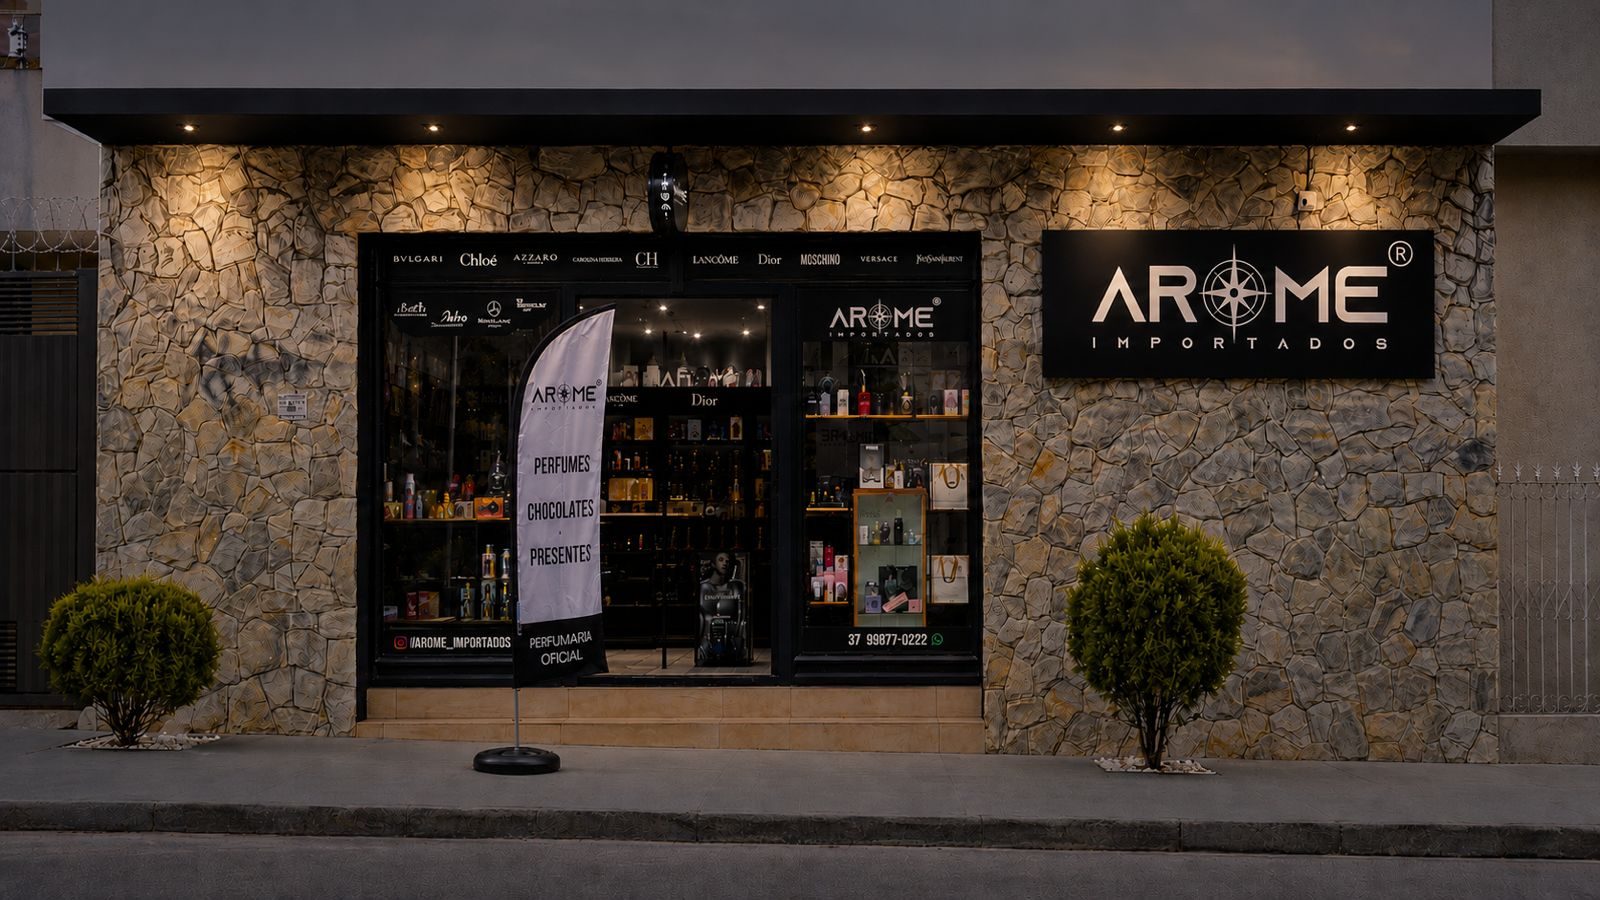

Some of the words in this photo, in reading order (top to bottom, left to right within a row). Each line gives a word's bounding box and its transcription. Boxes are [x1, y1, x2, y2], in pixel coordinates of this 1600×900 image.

[393, 255, 443, 263] BVLGARI
[459, 252, 498, 267] Chloé
[513, 253, 558, 262] AZZARO
[635, 252, 659, 266] CH
[758, 253, 782, 265] Dior
[800, 253, 841, 265] MOSCHINO
[860, 255, 898, 263] VERSACE
[1092, 336, 1388, 350] IMPORTADOS
[692, 393, 718, 407] Dior
[534, 455, 590, 474] PERFUMES
[527, 499, 594, 521] CHOCOLATES
[530, 544, 592, 566] PRESENTES
[530, 630, 593, 649] PERFUMARIA
[848, 633, 861, 646] 37
[866, 633, 928, 646] 99877-0222
[541, 649, 584, 666] OFICIAL
